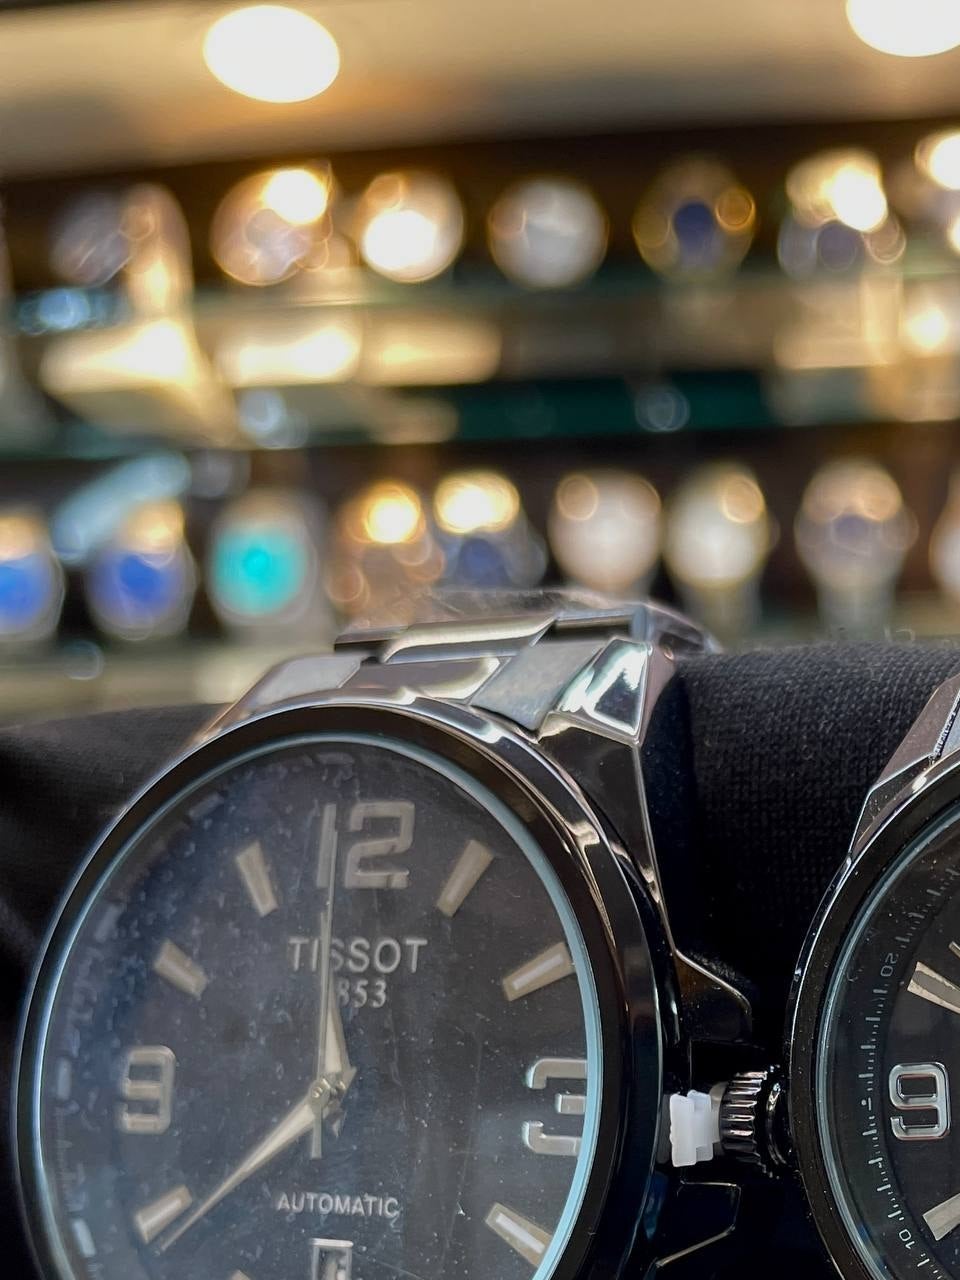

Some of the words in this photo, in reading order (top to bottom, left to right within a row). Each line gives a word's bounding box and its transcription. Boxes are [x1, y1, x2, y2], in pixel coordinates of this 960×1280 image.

[316, 800, 415, 889] 12
[288, 937, 428, 973] TISSOT
[328, 978, 388, 1008] 853
[119, 1045, 175, 1134] 9
[889, 1061, 951, 1141] 9
[277, 1191, 400, 1217] AUTOMATIC
